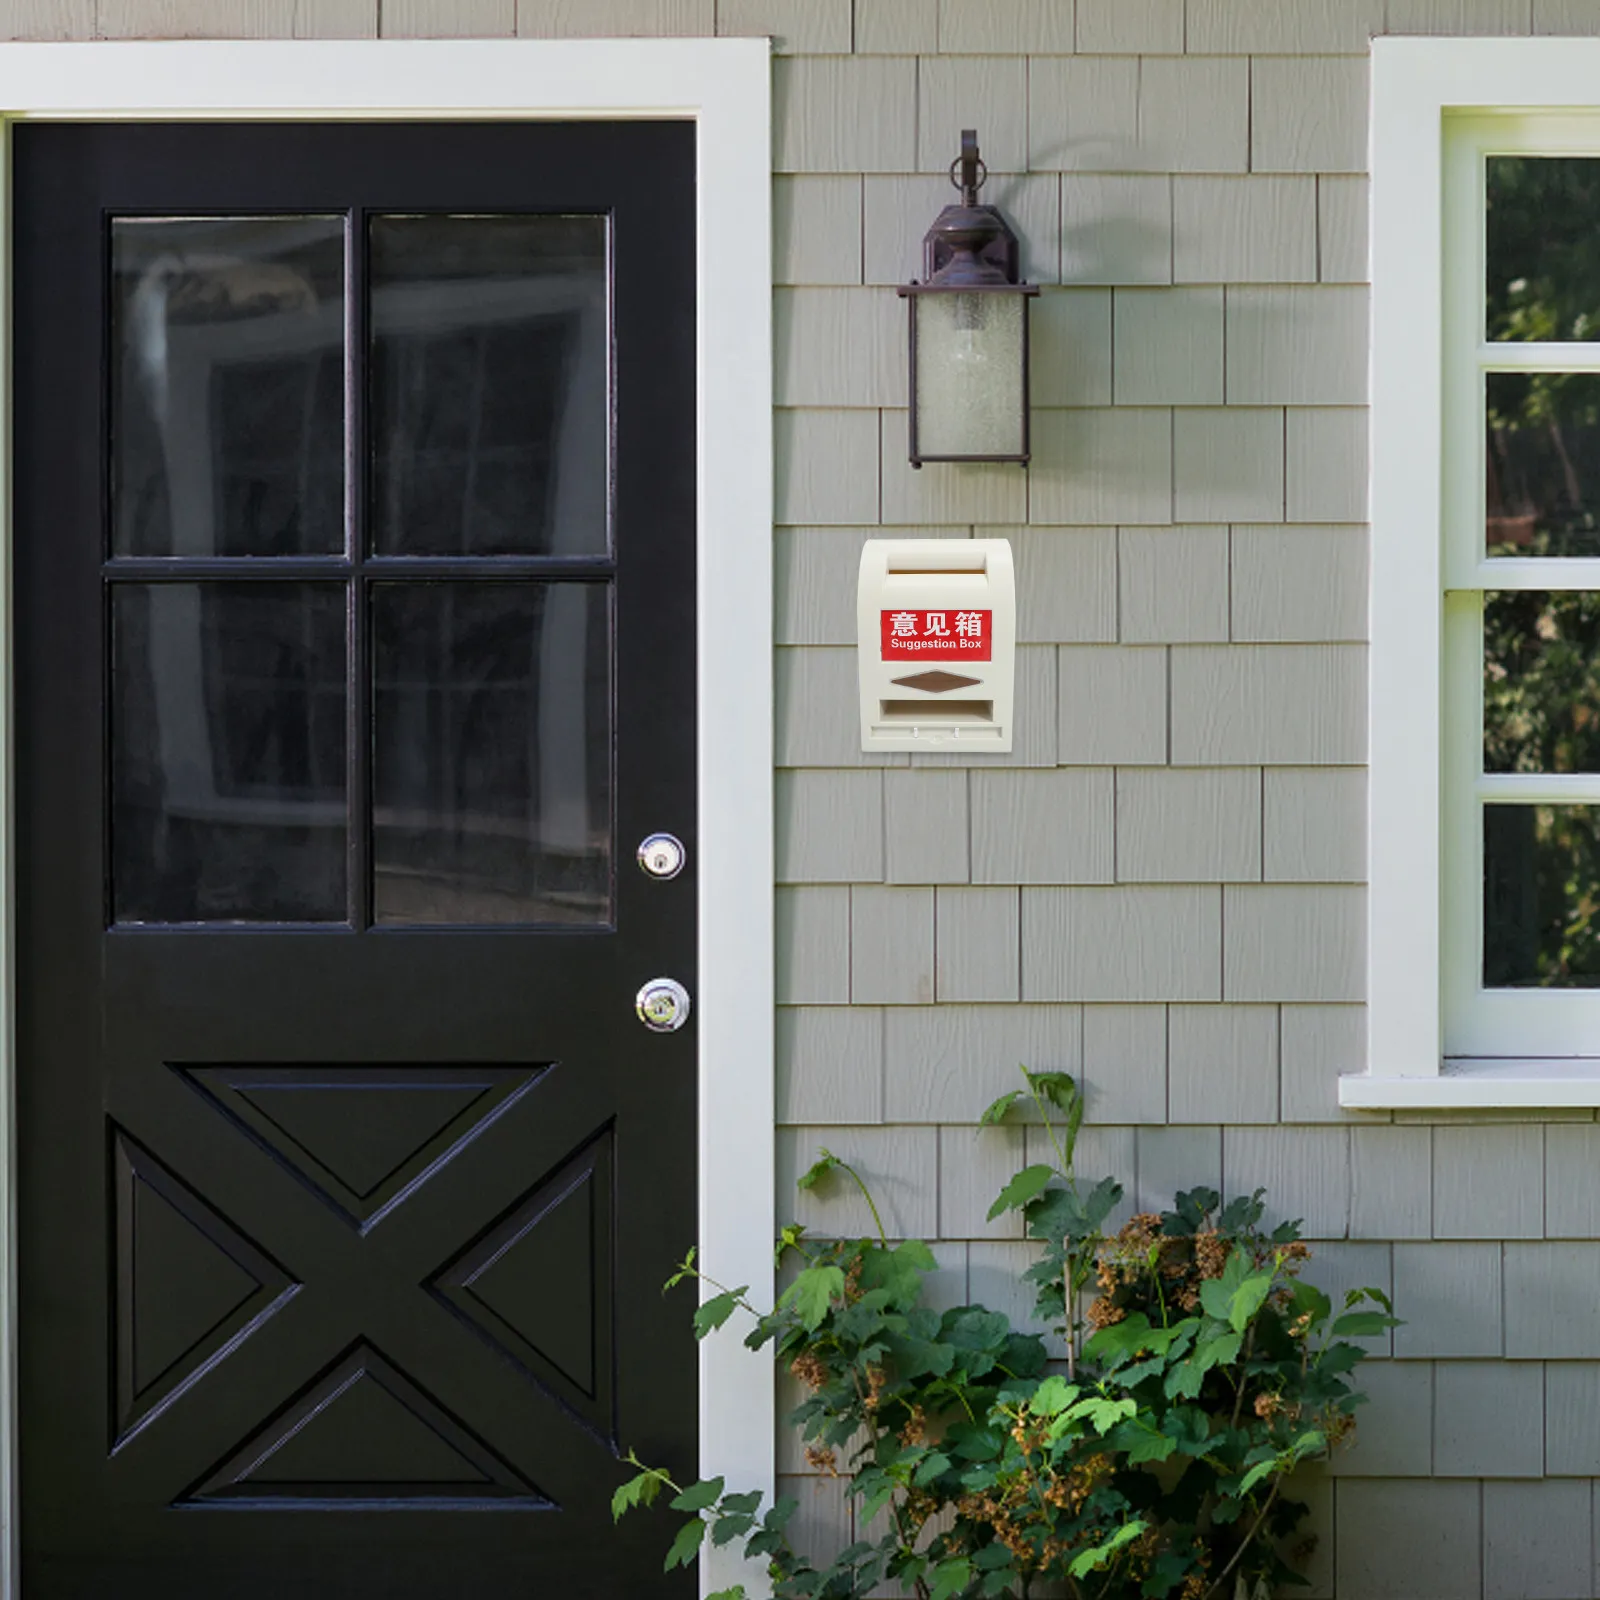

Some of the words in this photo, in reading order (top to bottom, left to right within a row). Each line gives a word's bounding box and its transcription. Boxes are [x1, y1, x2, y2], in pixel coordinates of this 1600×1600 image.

[889, 611, 983, 636] 意见箱
[891, 638, 956, 650] Suggestion
[959, 638, 982, 649] Box
